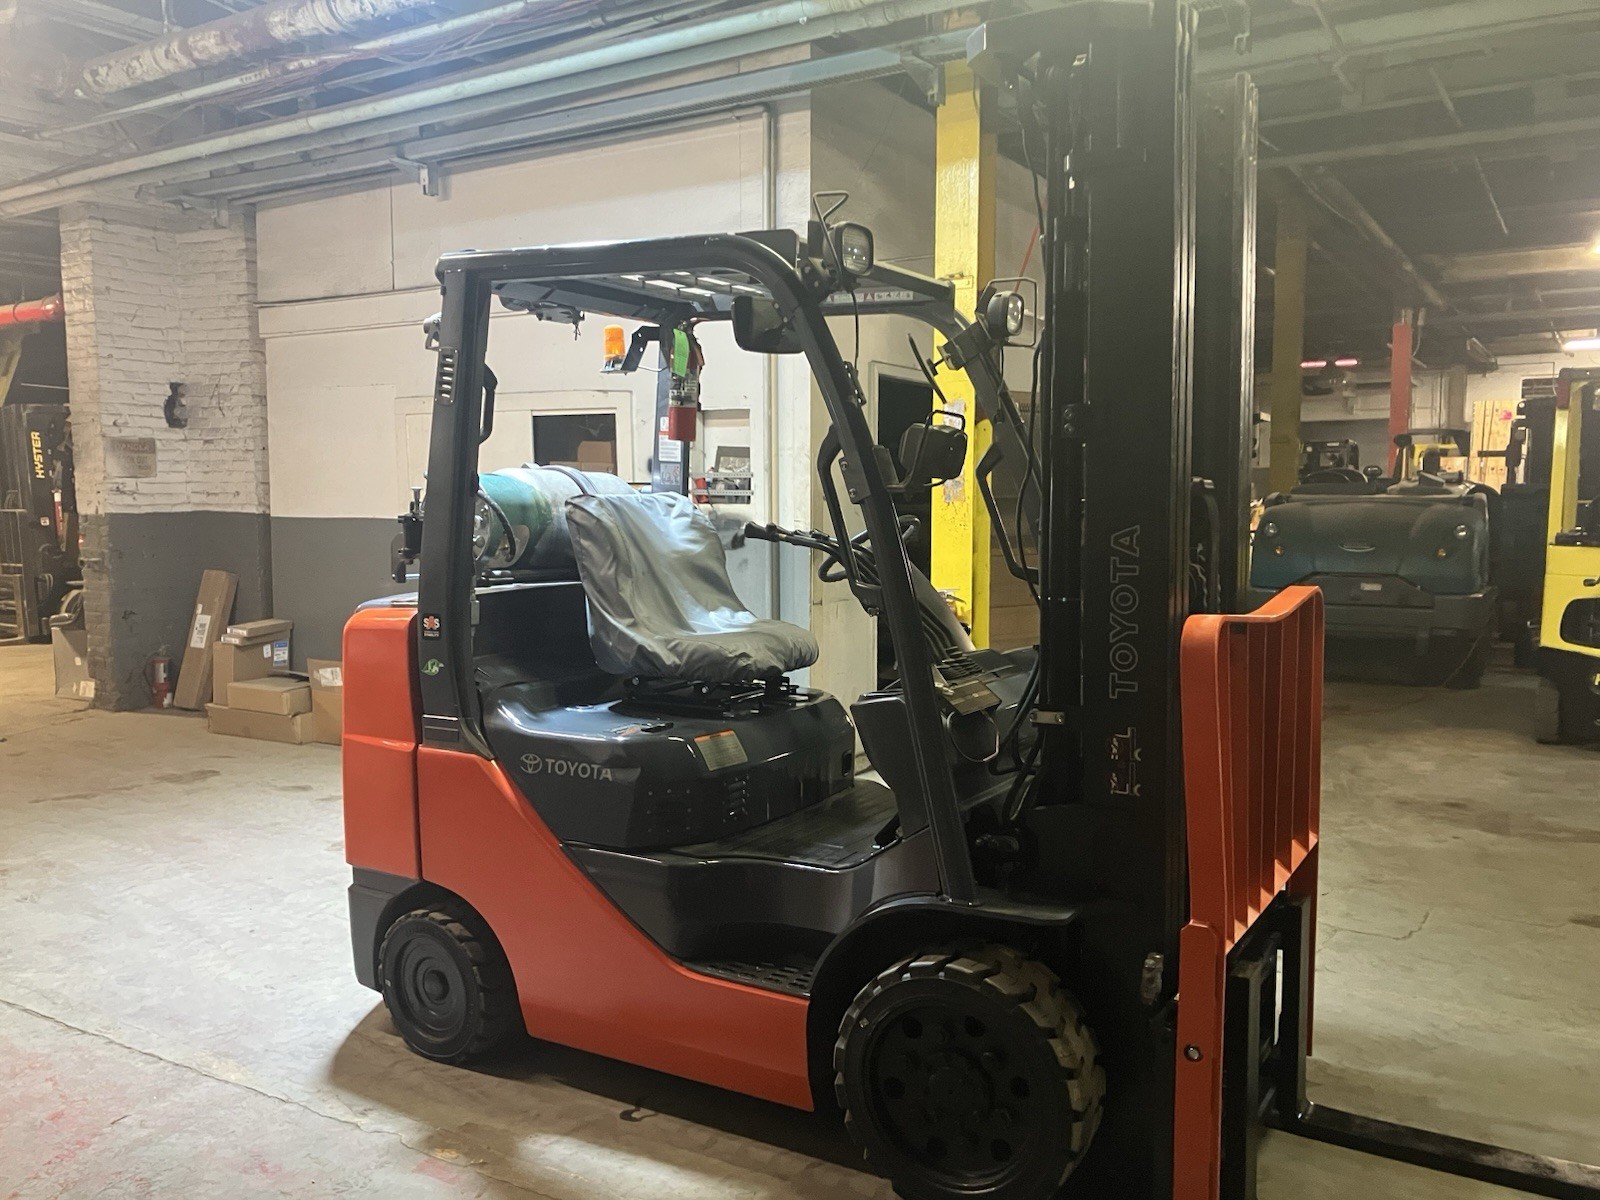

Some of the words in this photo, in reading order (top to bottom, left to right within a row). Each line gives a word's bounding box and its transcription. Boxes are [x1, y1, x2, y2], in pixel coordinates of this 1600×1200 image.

[31, 431, 45, 479] HYSTER
[1109, 525, 1140, 699] TOYOTA
[545, 758, 612, 782] TOYOTA
